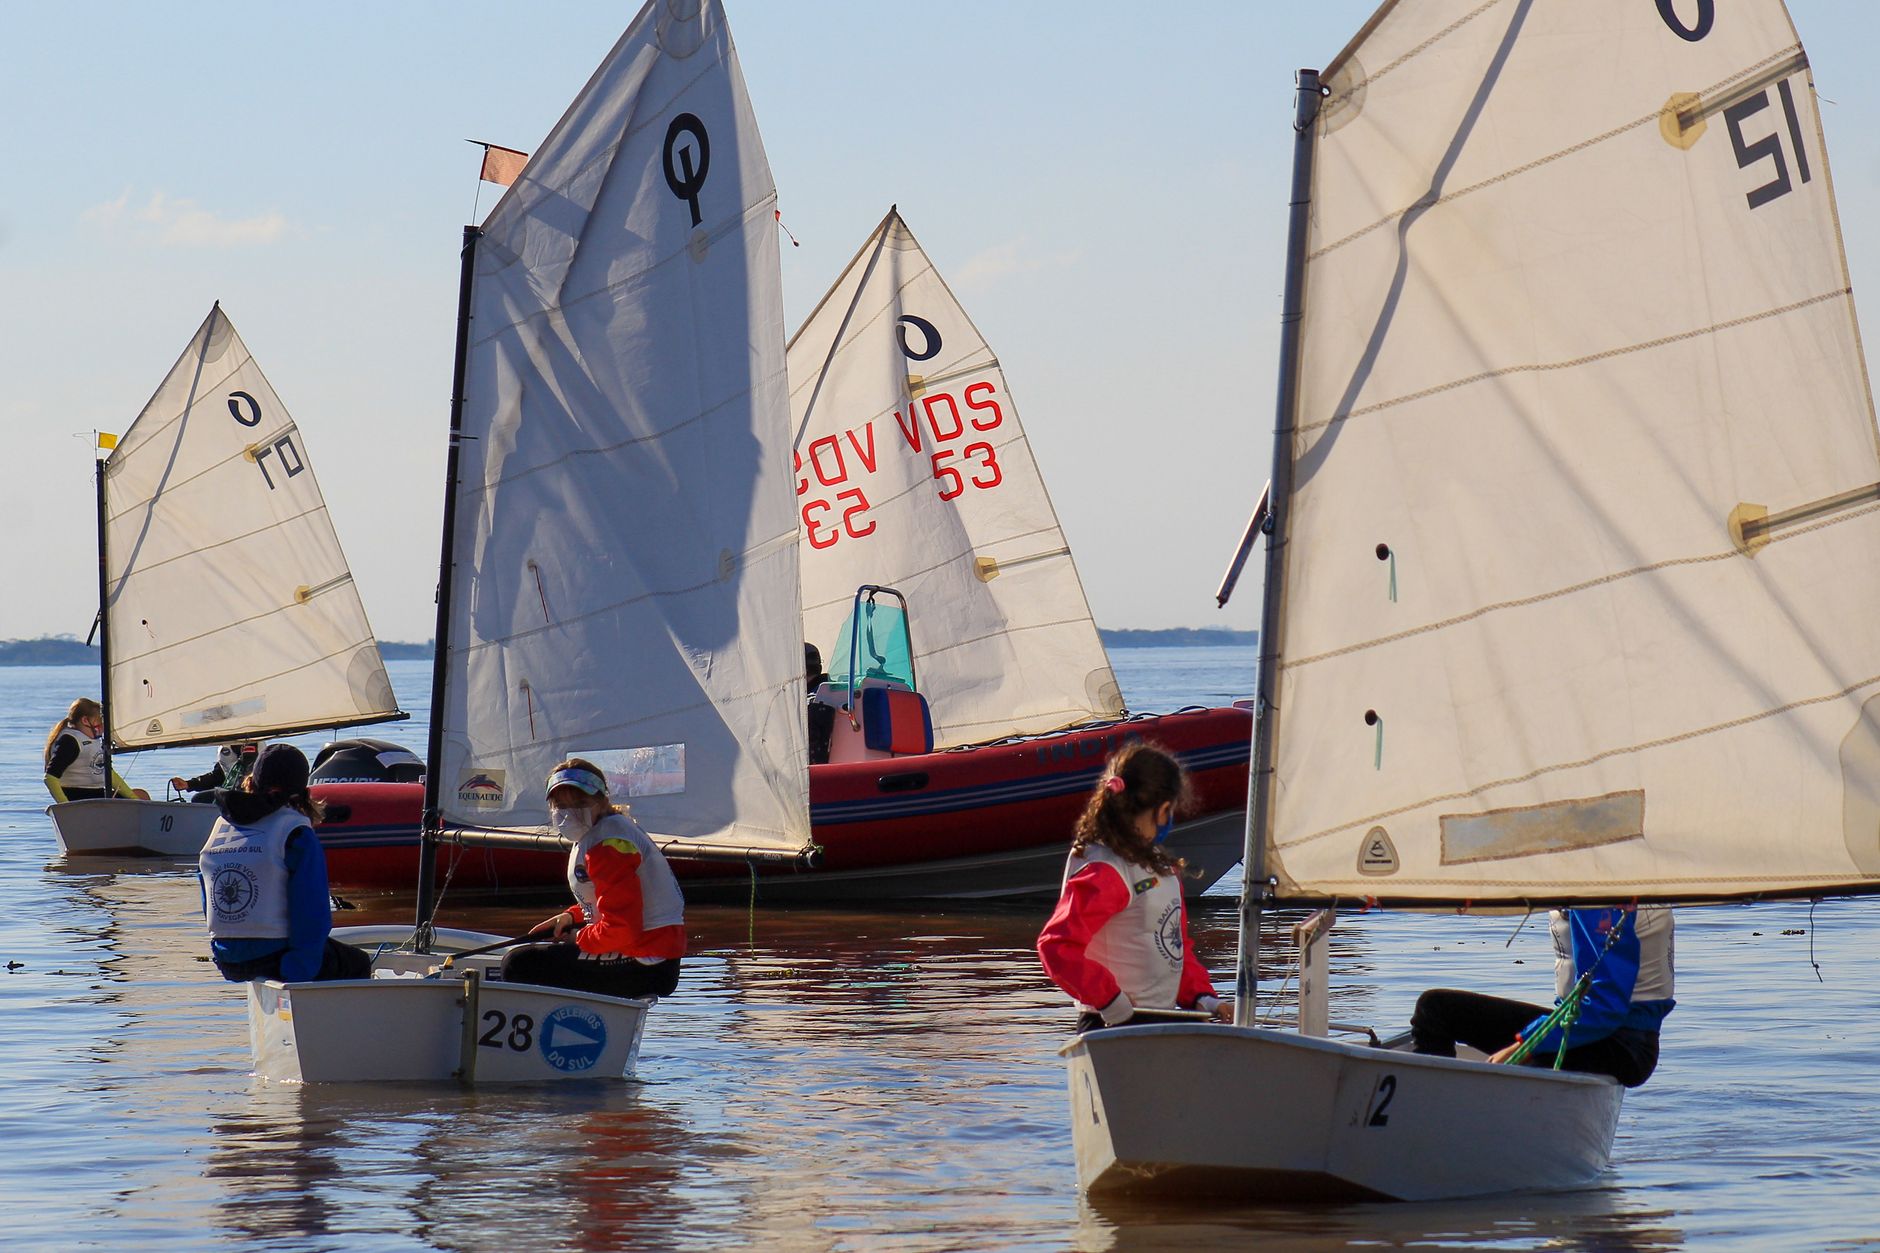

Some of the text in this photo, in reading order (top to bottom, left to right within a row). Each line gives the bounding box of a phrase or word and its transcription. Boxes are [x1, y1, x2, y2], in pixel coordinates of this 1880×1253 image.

[894, 381, 1003, 453] VDS
[931, 441, 1002, 501] 53
[160, 814, 174, 832] 10
[238, 846, 248, 854] DO
[249, 845, 263, 853] SUL
[551, 1008, 601, 1030] VELEIROS
[478, 1009, 534, 1052] 28
[548, 1050, 593, 1071] DO SUL
